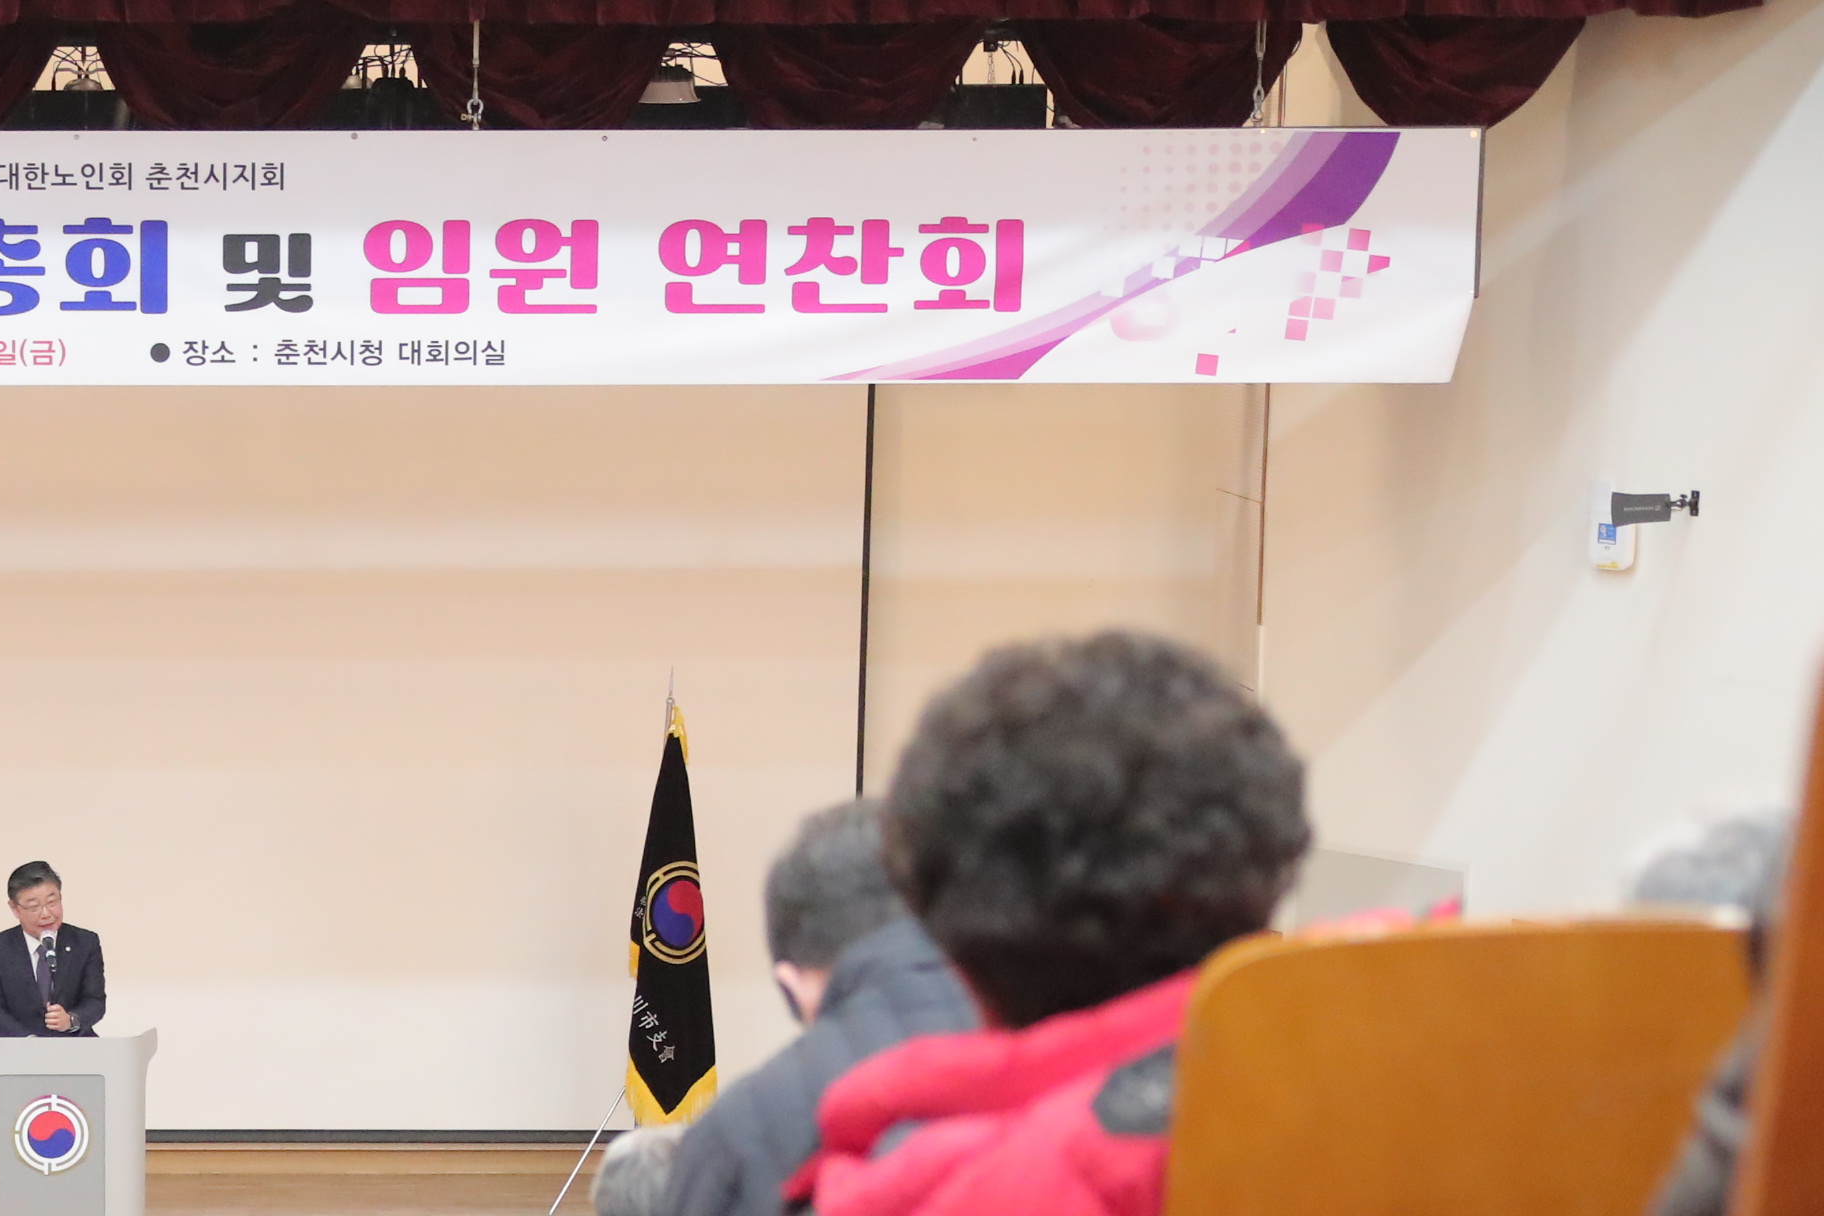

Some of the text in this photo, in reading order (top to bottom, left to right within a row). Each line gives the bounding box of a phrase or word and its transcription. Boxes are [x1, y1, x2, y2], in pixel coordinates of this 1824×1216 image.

[144, 161, 285, 192] 춘천시지회
[222, 232, 314, 314] 및
[362, 217, 600, 315] 임원
[657, 215, 1025, 315] 연찬회
[182, 339, 237, 367] 장소
[273, 338, 383, 367] 춘천시청
[398, 339, 506, 367] 대회의실
